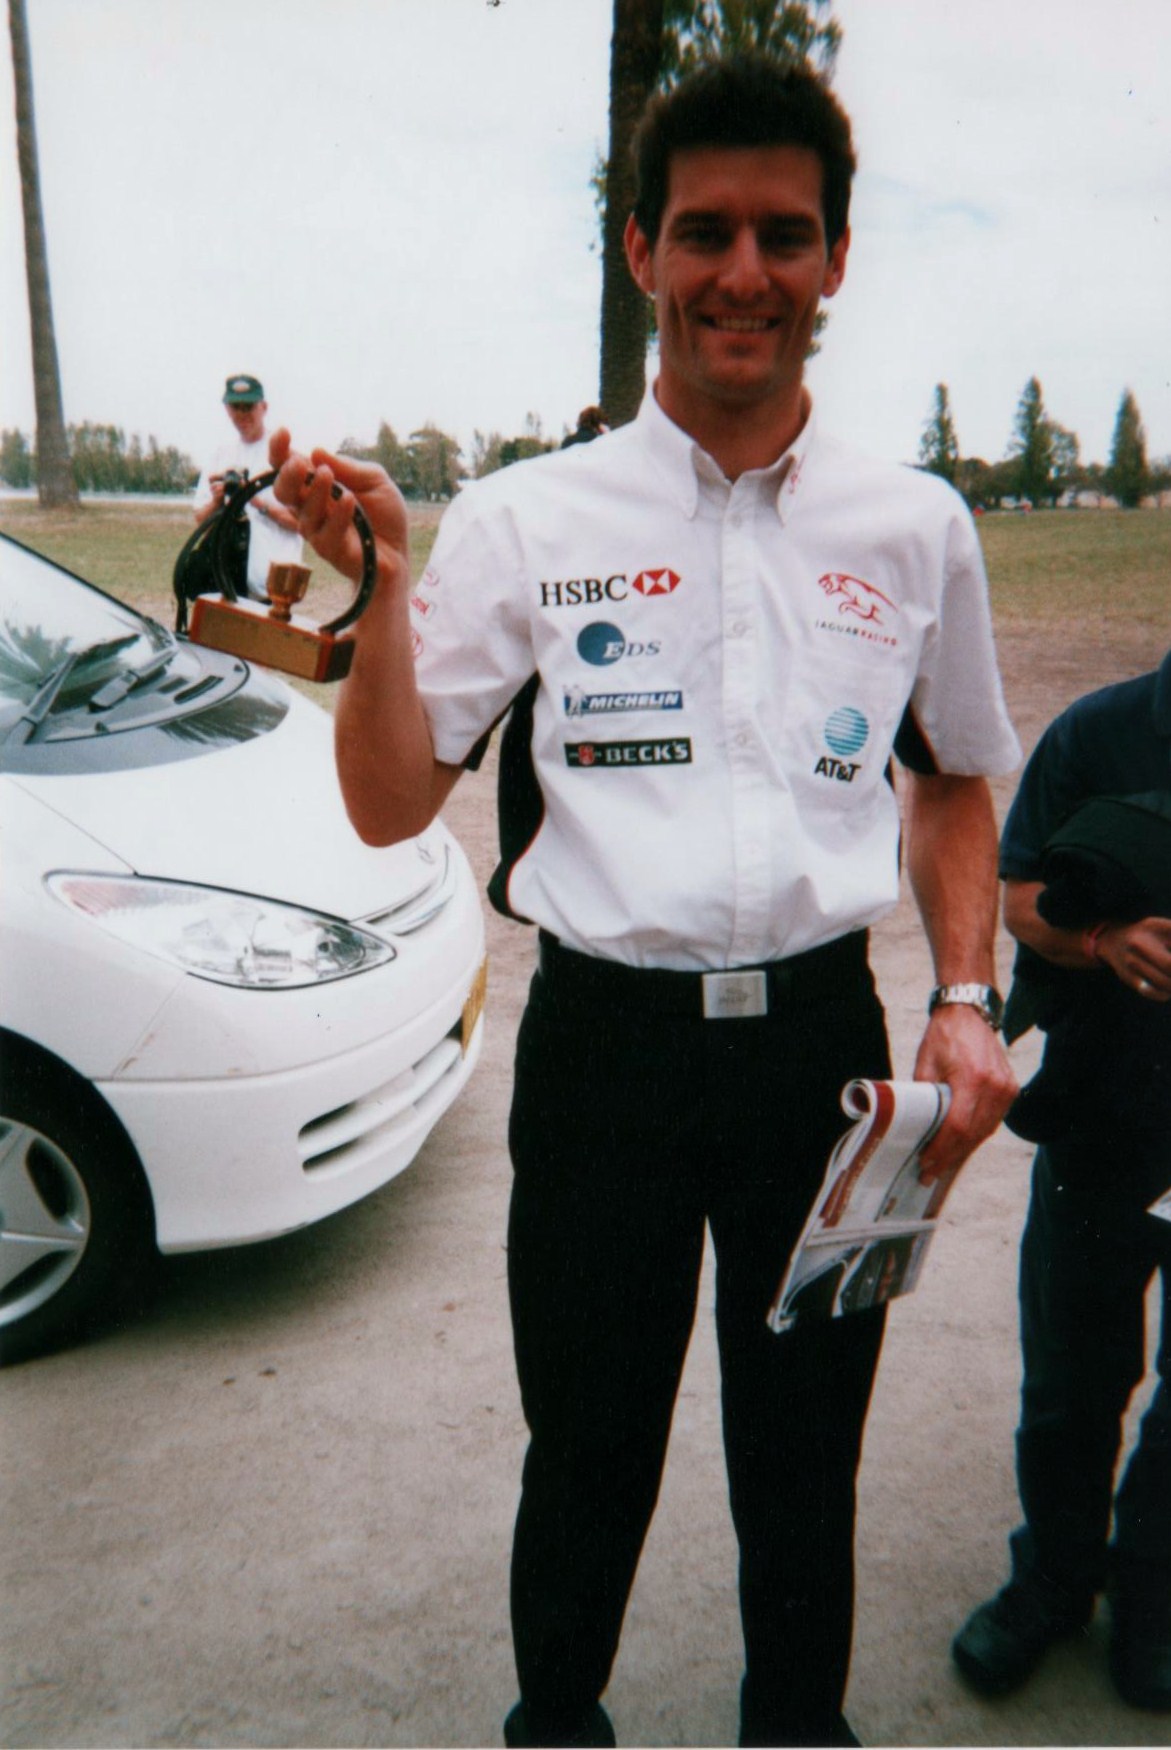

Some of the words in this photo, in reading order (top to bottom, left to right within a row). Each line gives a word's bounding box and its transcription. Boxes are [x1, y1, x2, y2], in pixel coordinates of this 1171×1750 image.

[540, 574, 628, 606] HSBC
[603, 641, 662, 659] EDS
[589, 692, 679, 710] MICHELIN
[605, 742, 688, 763] BECK'S
[814, 756, 862, 782] AT&T
